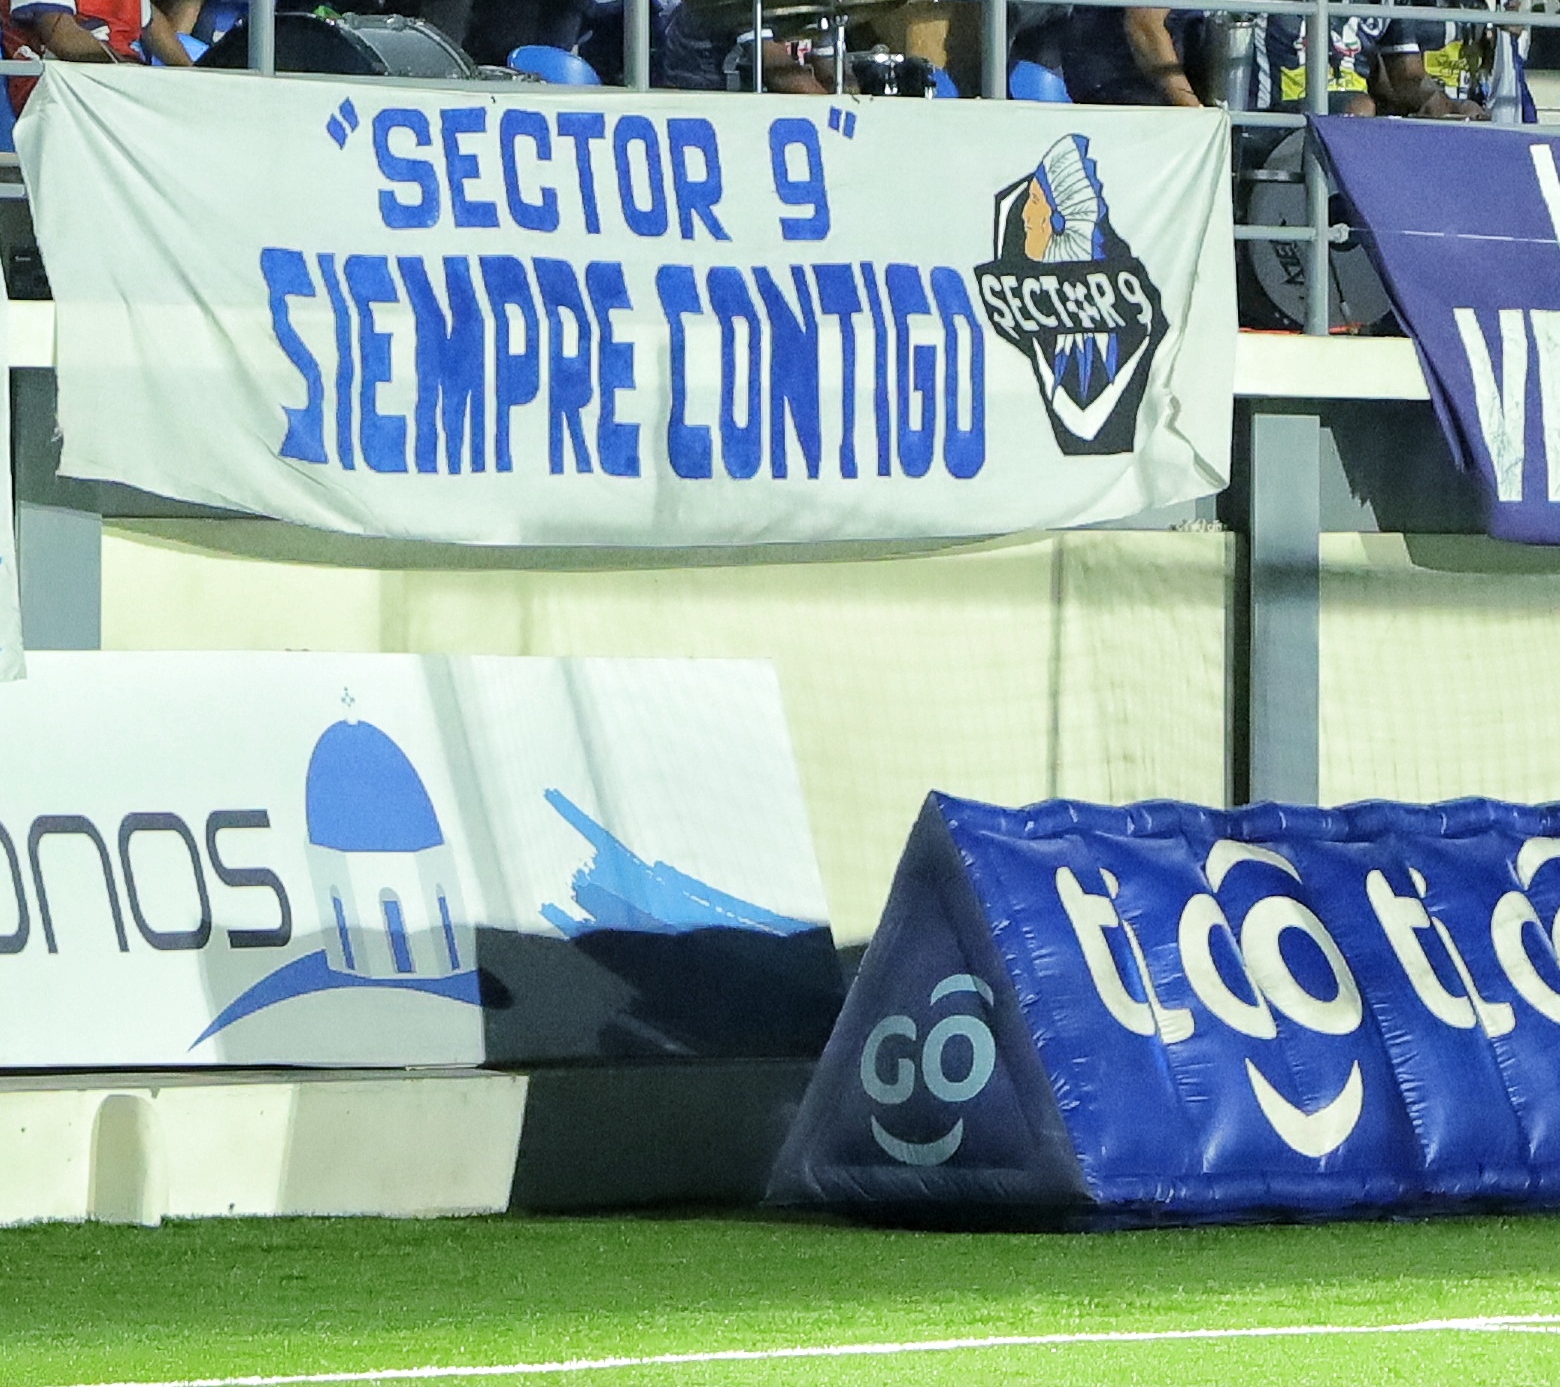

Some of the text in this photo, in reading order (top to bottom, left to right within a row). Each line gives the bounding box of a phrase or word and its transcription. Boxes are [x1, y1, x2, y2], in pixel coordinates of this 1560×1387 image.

[260, 247, 986, 481] SIEMPRE CONTIGO
[1117, 271, 1153, 325] 9
